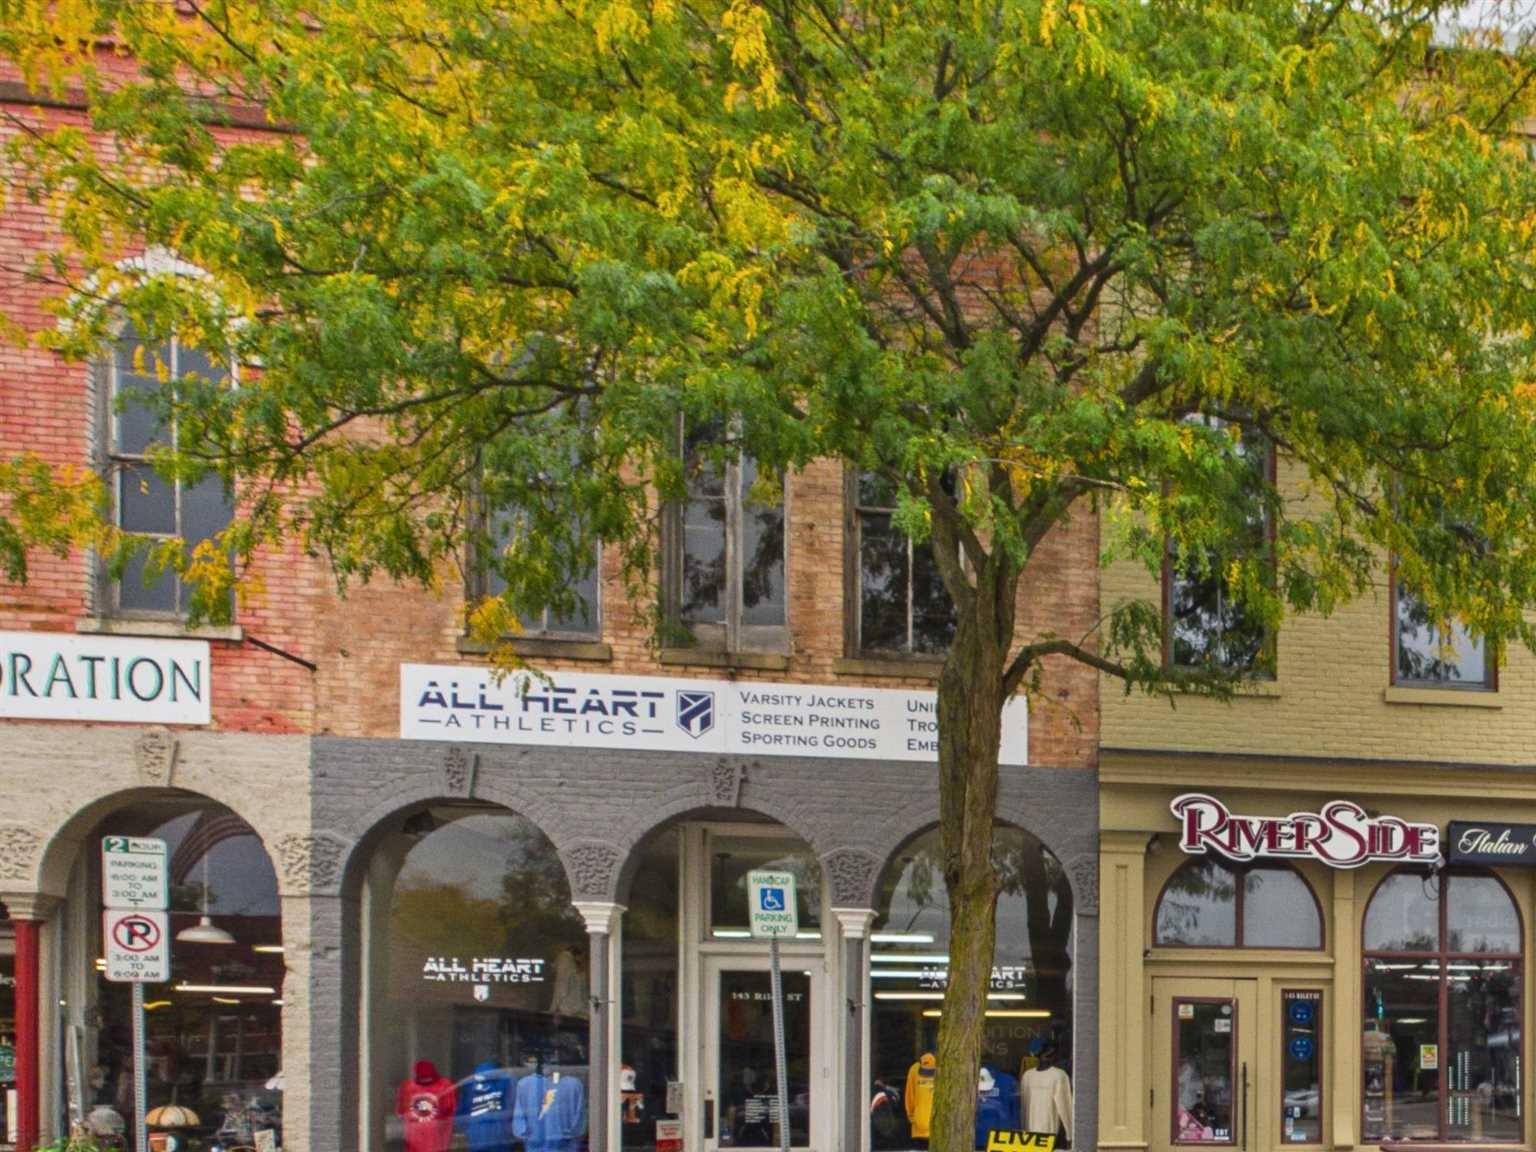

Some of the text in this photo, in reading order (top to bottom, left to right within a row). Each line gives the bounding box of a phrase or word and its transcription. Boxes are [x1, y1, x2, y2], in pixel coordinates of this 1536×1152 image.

[0, 652, 201, 702] RATION
[418, 681, 665, 718] ALL HEART
[740, 691, 875, 710] VARSITY JACKETS
[907, 699, 938, 713] UNI
[445, 713, 637, 735] ATHLETICS
[741, 711, 880, 730] SCREEN PRINTING
[907, 719, 937, 733] TRO
[741, 731, 877, 750] SPORTING GOODS
[907, 738, 939, 752] EMB
[110, 839, 125, 851] 2
[1458, 828, 1527, 855] Italian
[424, 957, 544, 973] ALL HEART
[436, 973, 530, 982] ATHLETICS
[993, 1131, 1049, 1147] LIVE
